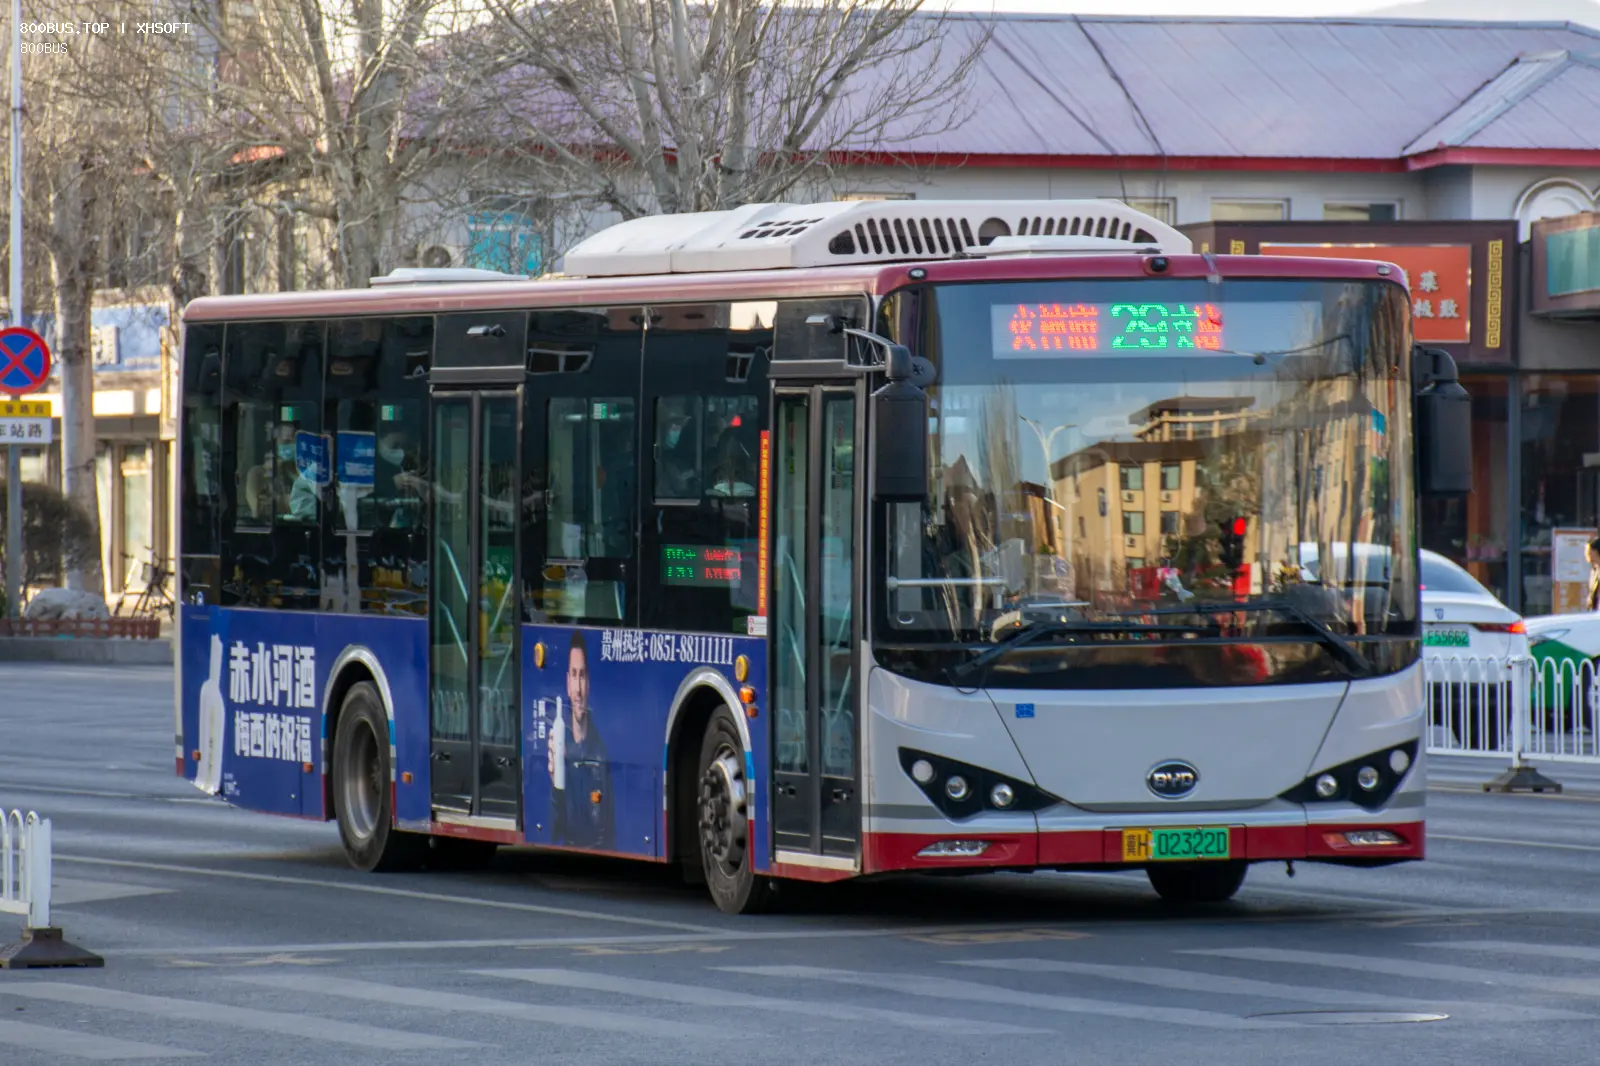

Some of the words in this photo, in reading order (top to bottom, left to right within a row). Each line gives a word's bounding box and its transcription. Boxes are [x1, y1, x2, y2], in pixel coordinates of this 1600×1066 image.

[228, 640, 316, 708] 赤水河酒
[233, 710, 313, 763] 梅西的祝福
[1152, 771, 1195, 789] BYD
